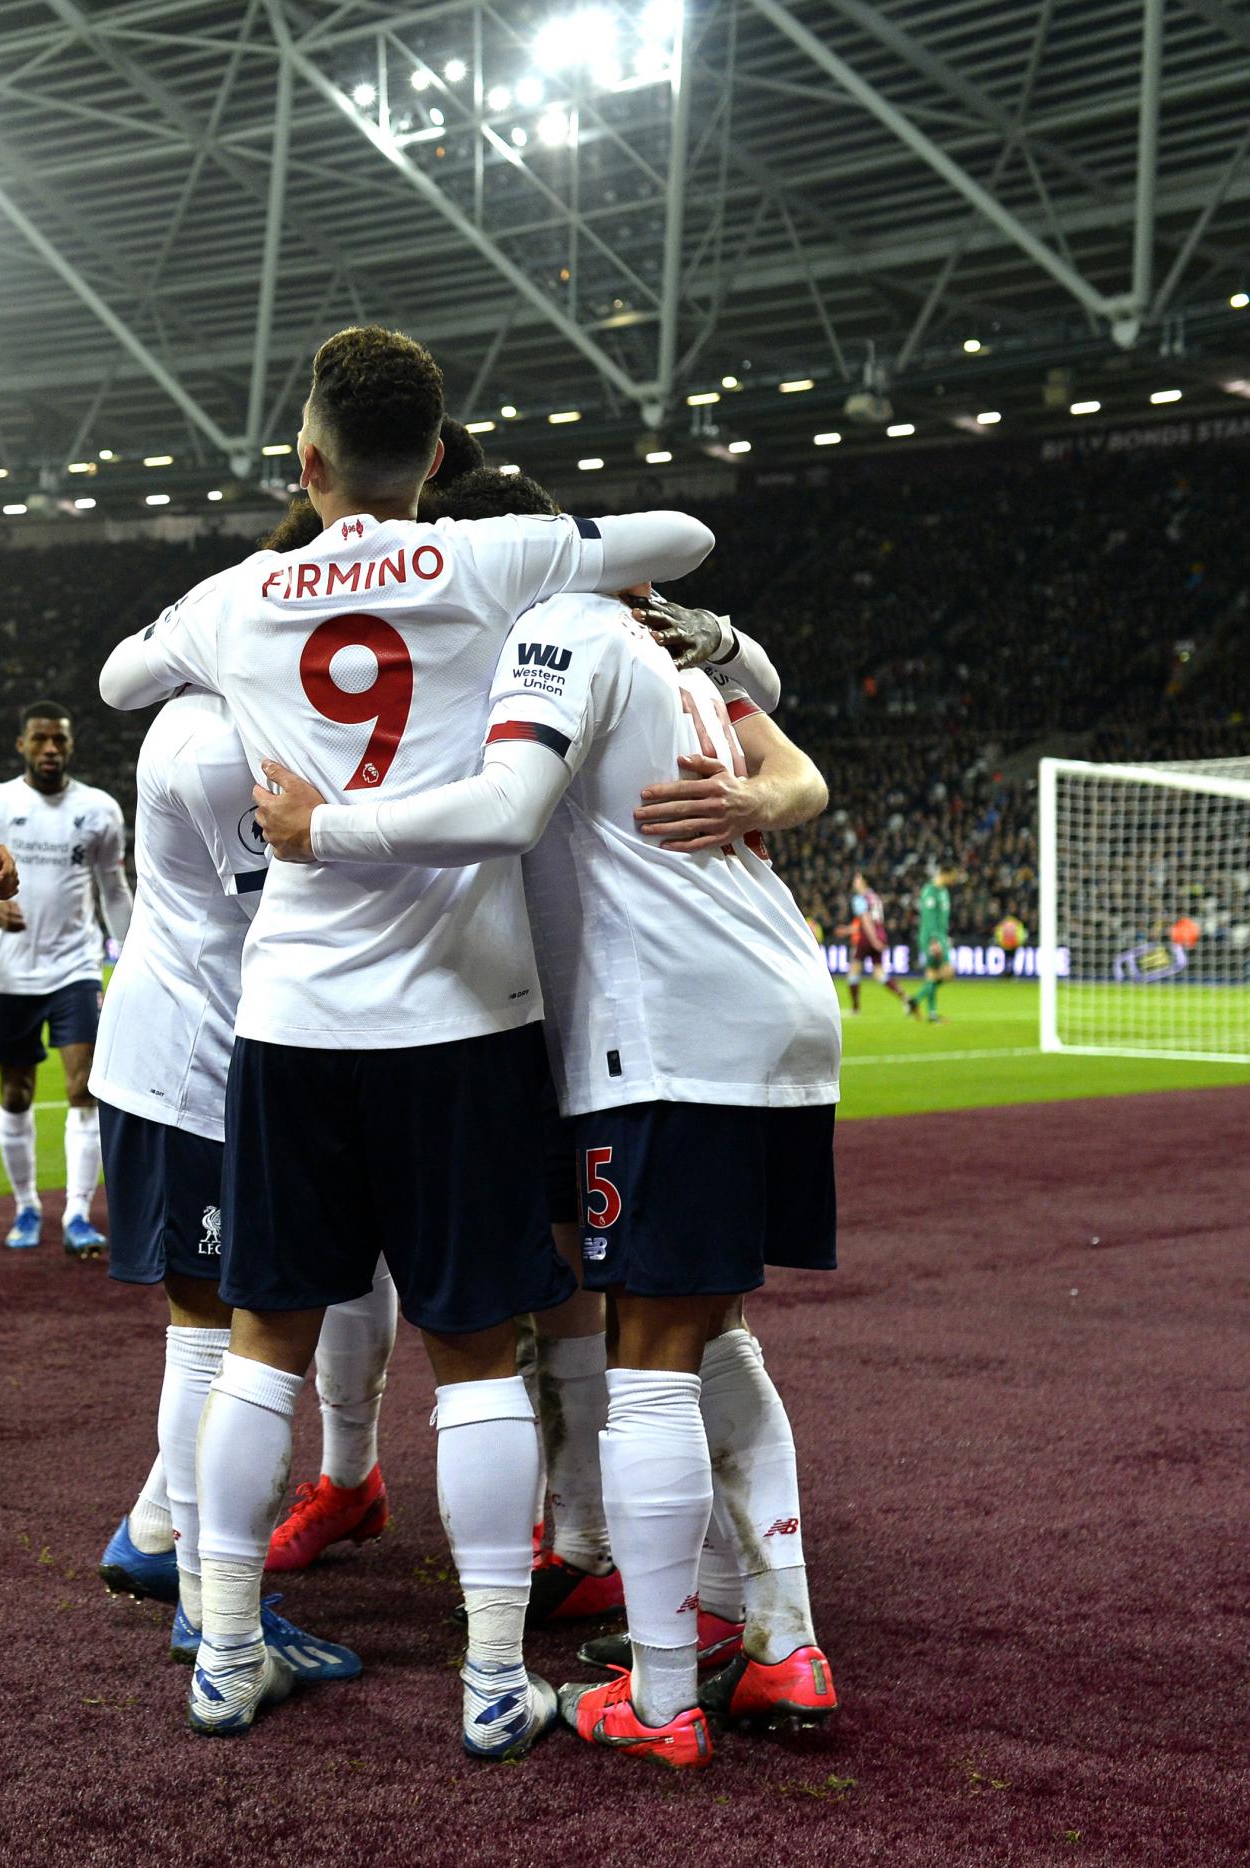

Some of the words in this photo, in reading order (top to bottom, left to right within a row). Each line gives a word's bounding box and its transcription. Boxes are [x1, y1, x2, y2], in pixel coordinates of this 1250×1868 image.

[262, 545, 444, 600] FIRMINO
[517, 643, 573, 672] WU
[512, 667, 566, 686] Western
[523, 678, 563, 697] Union
[299, 613, 414, 791] 9
